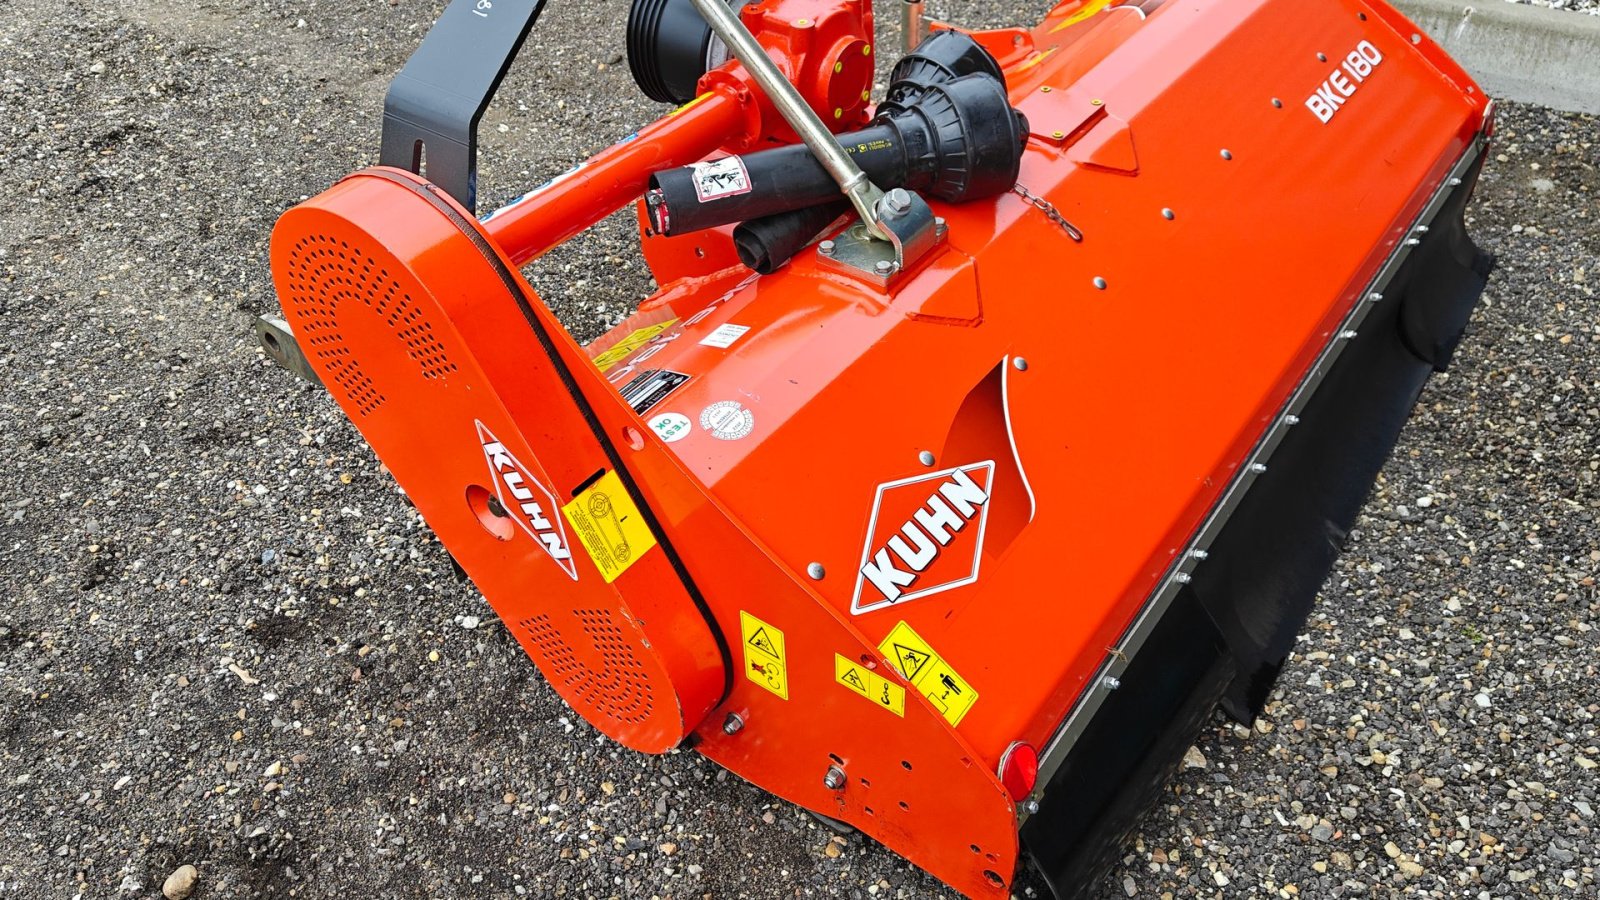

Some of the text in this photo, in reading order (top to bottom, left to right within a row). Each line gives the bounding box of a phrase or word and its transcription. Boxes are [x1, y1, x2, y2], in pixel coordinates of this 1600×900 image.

[1304, 39, 1384, 124] BKE 180
[655, 418, 671, 431] OK
[661, 420, 688, 441] TEST
[483, 441, 571, 561] KUHN
[861, 468, 989, 603] KUHN
